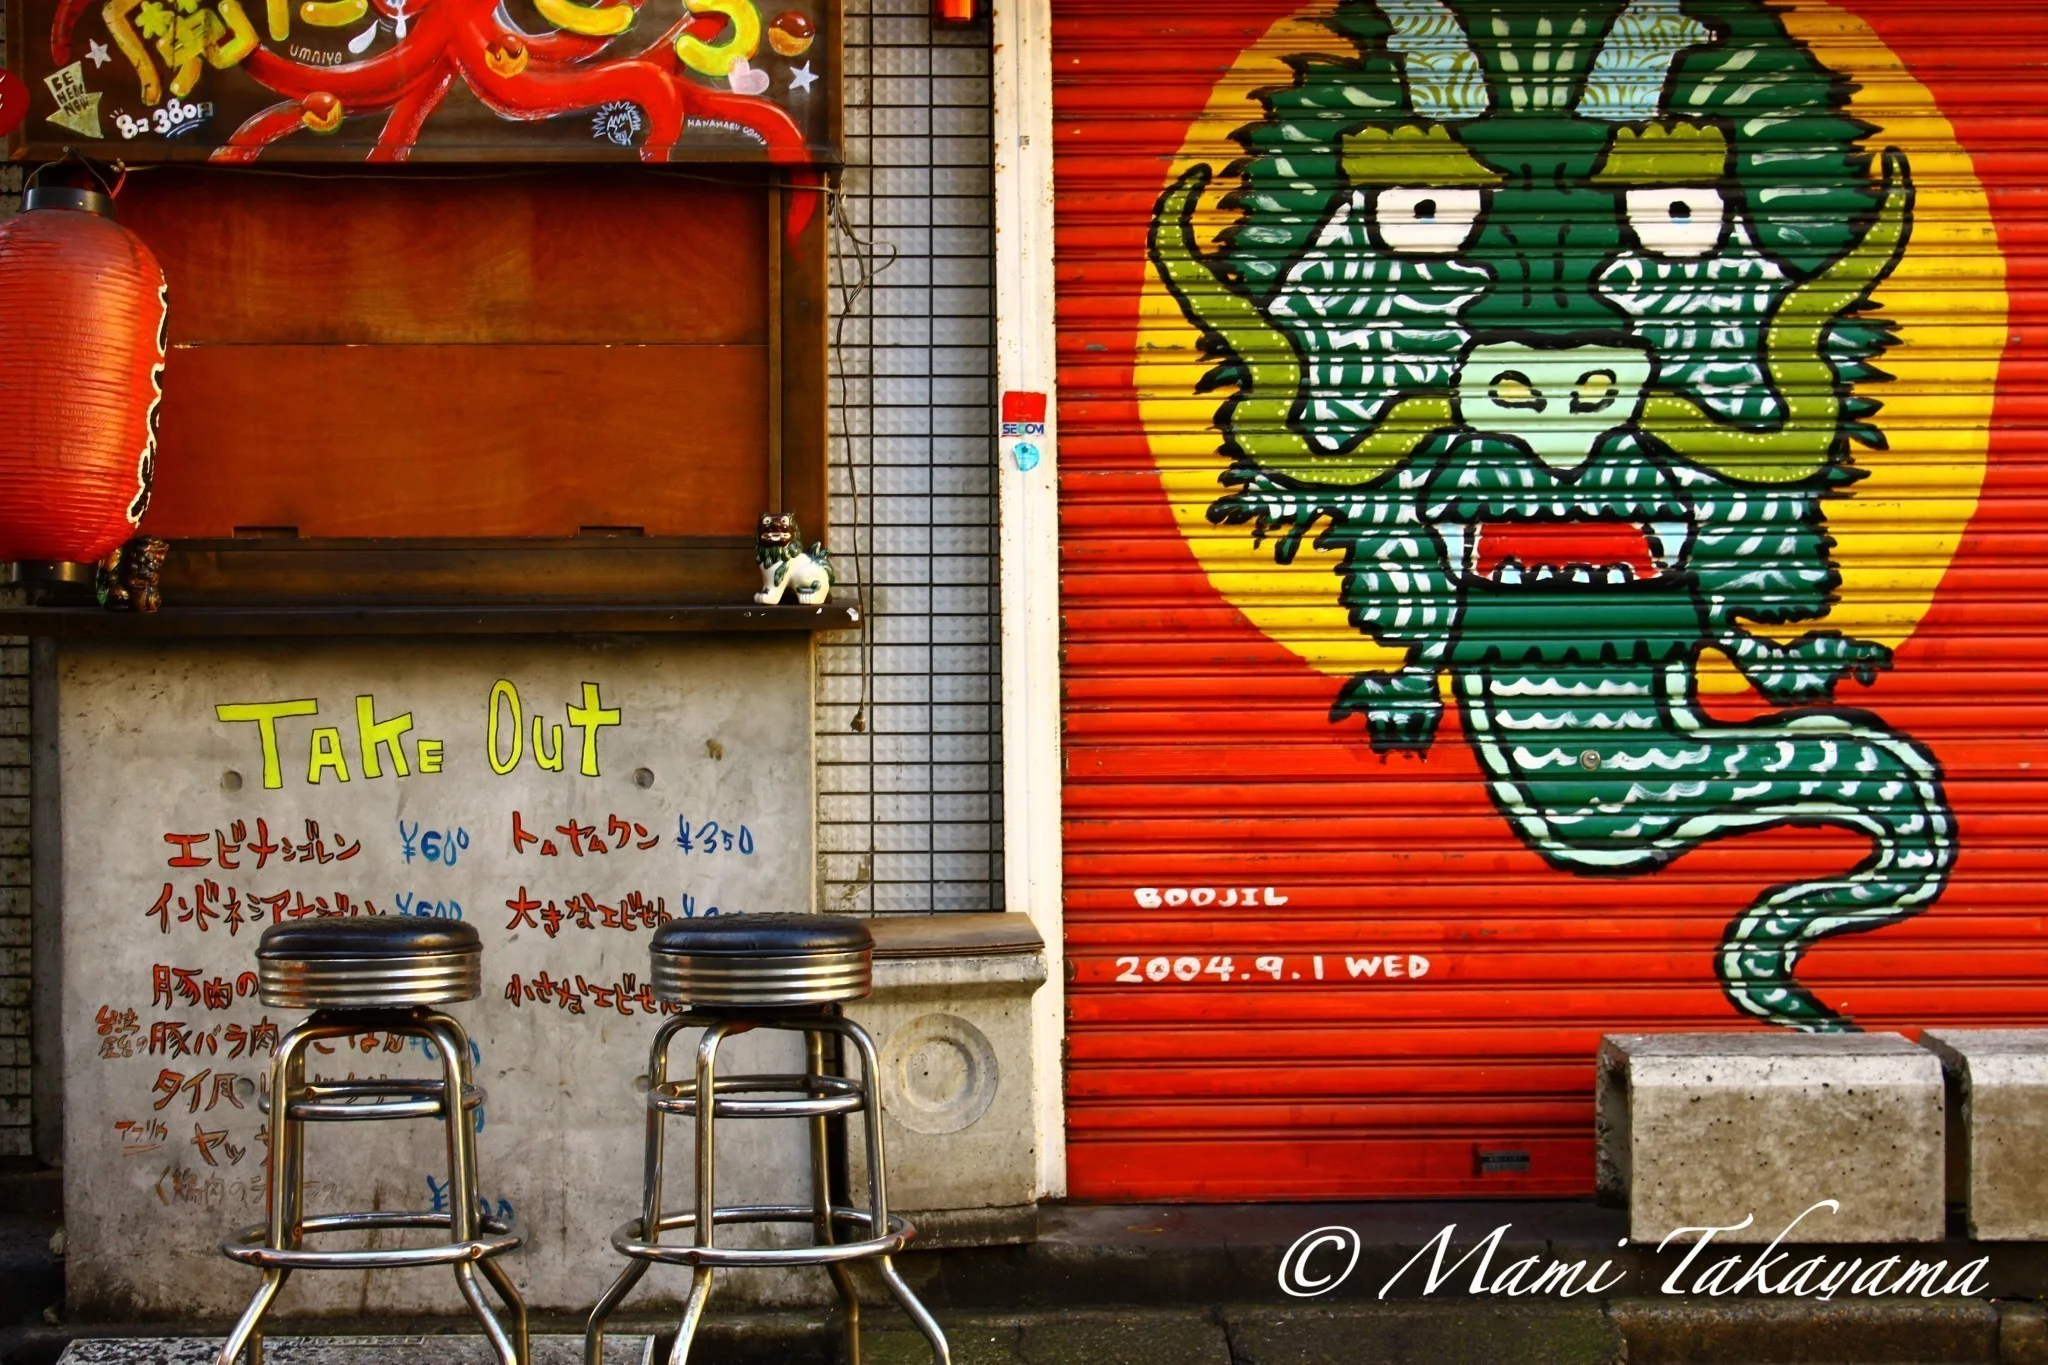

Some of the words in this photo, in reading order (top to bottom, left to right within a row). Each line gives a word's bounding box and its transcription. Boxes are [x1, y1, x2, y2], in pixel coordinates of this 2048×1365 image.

[51, 71, 74, 91] BE
[1002, 423, 1045, 435] SECOM
[1133, 887, 1289, 909] BOOJIL
[1344, 955, 1430, 979] WED
